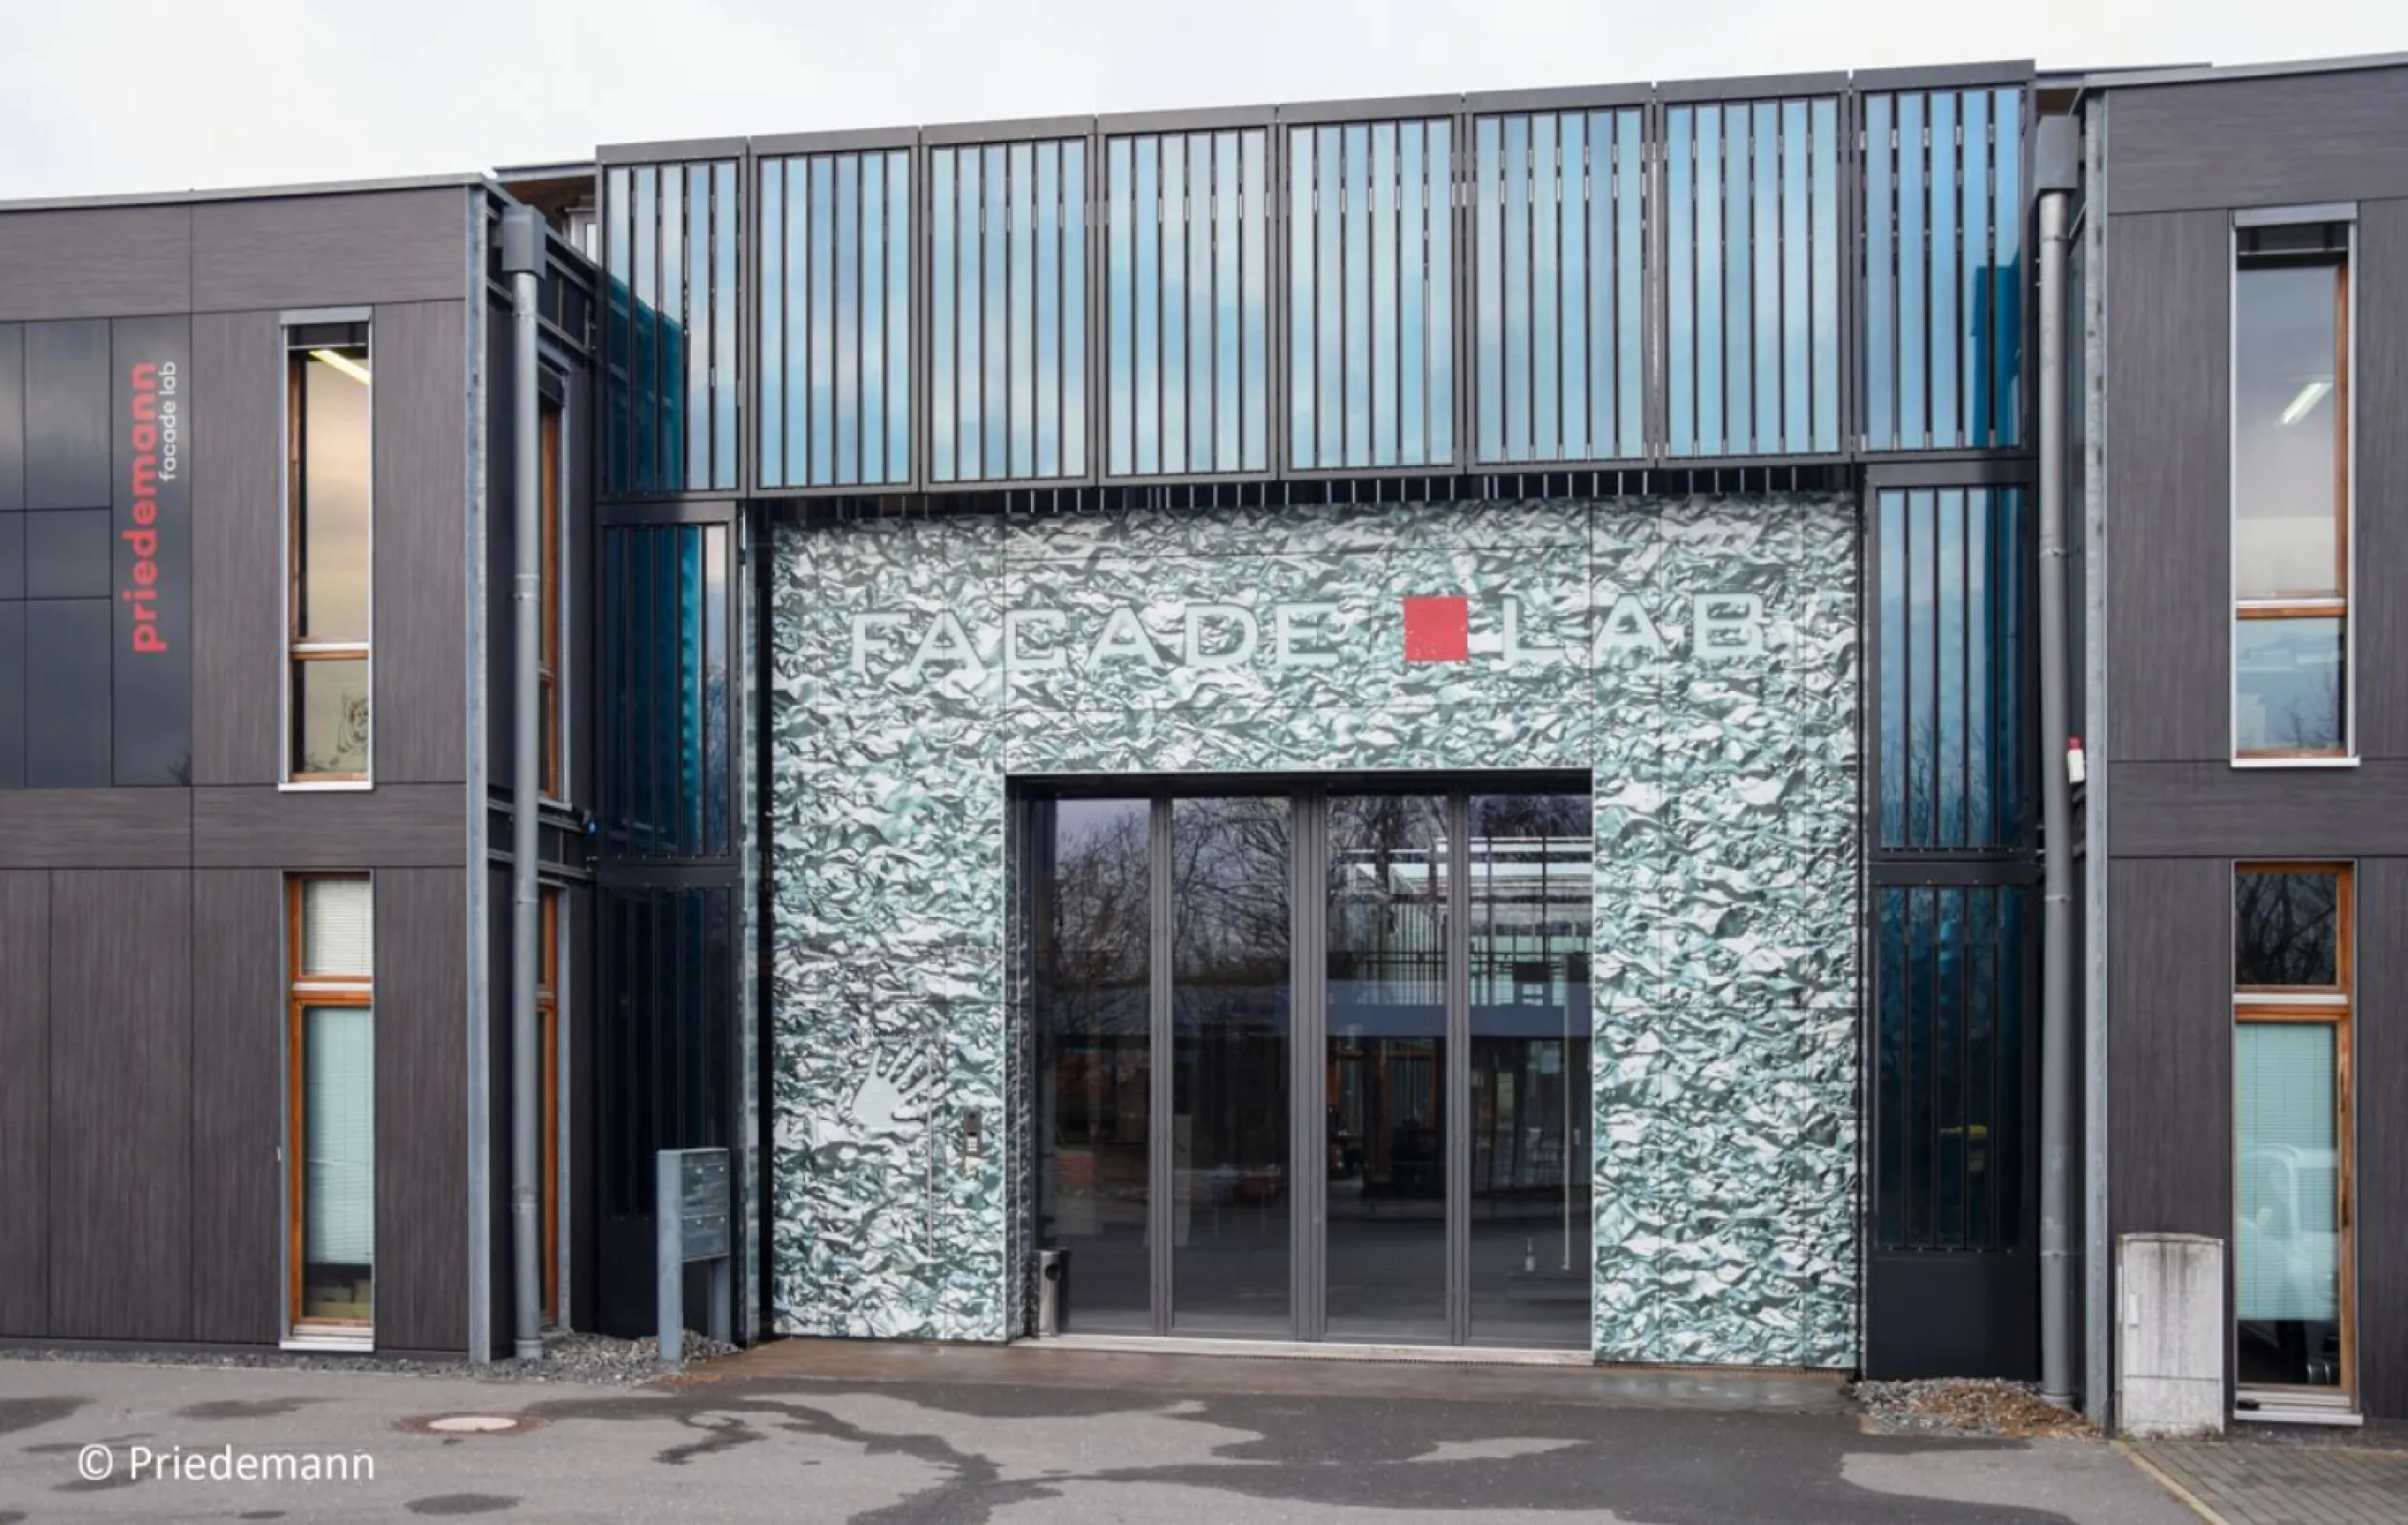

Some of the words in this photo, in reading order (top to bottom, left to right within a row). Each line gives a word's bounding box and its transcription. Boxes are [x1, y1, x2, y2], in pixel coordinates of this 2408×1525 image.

[158, 360, 176, 396] lab
[158, 400, 176, 482] facade
[122, 361, 168, 653] priedemann
[850, 601, 1340, 671] FACADE
[1503, 592, 1765, 661] LAB
